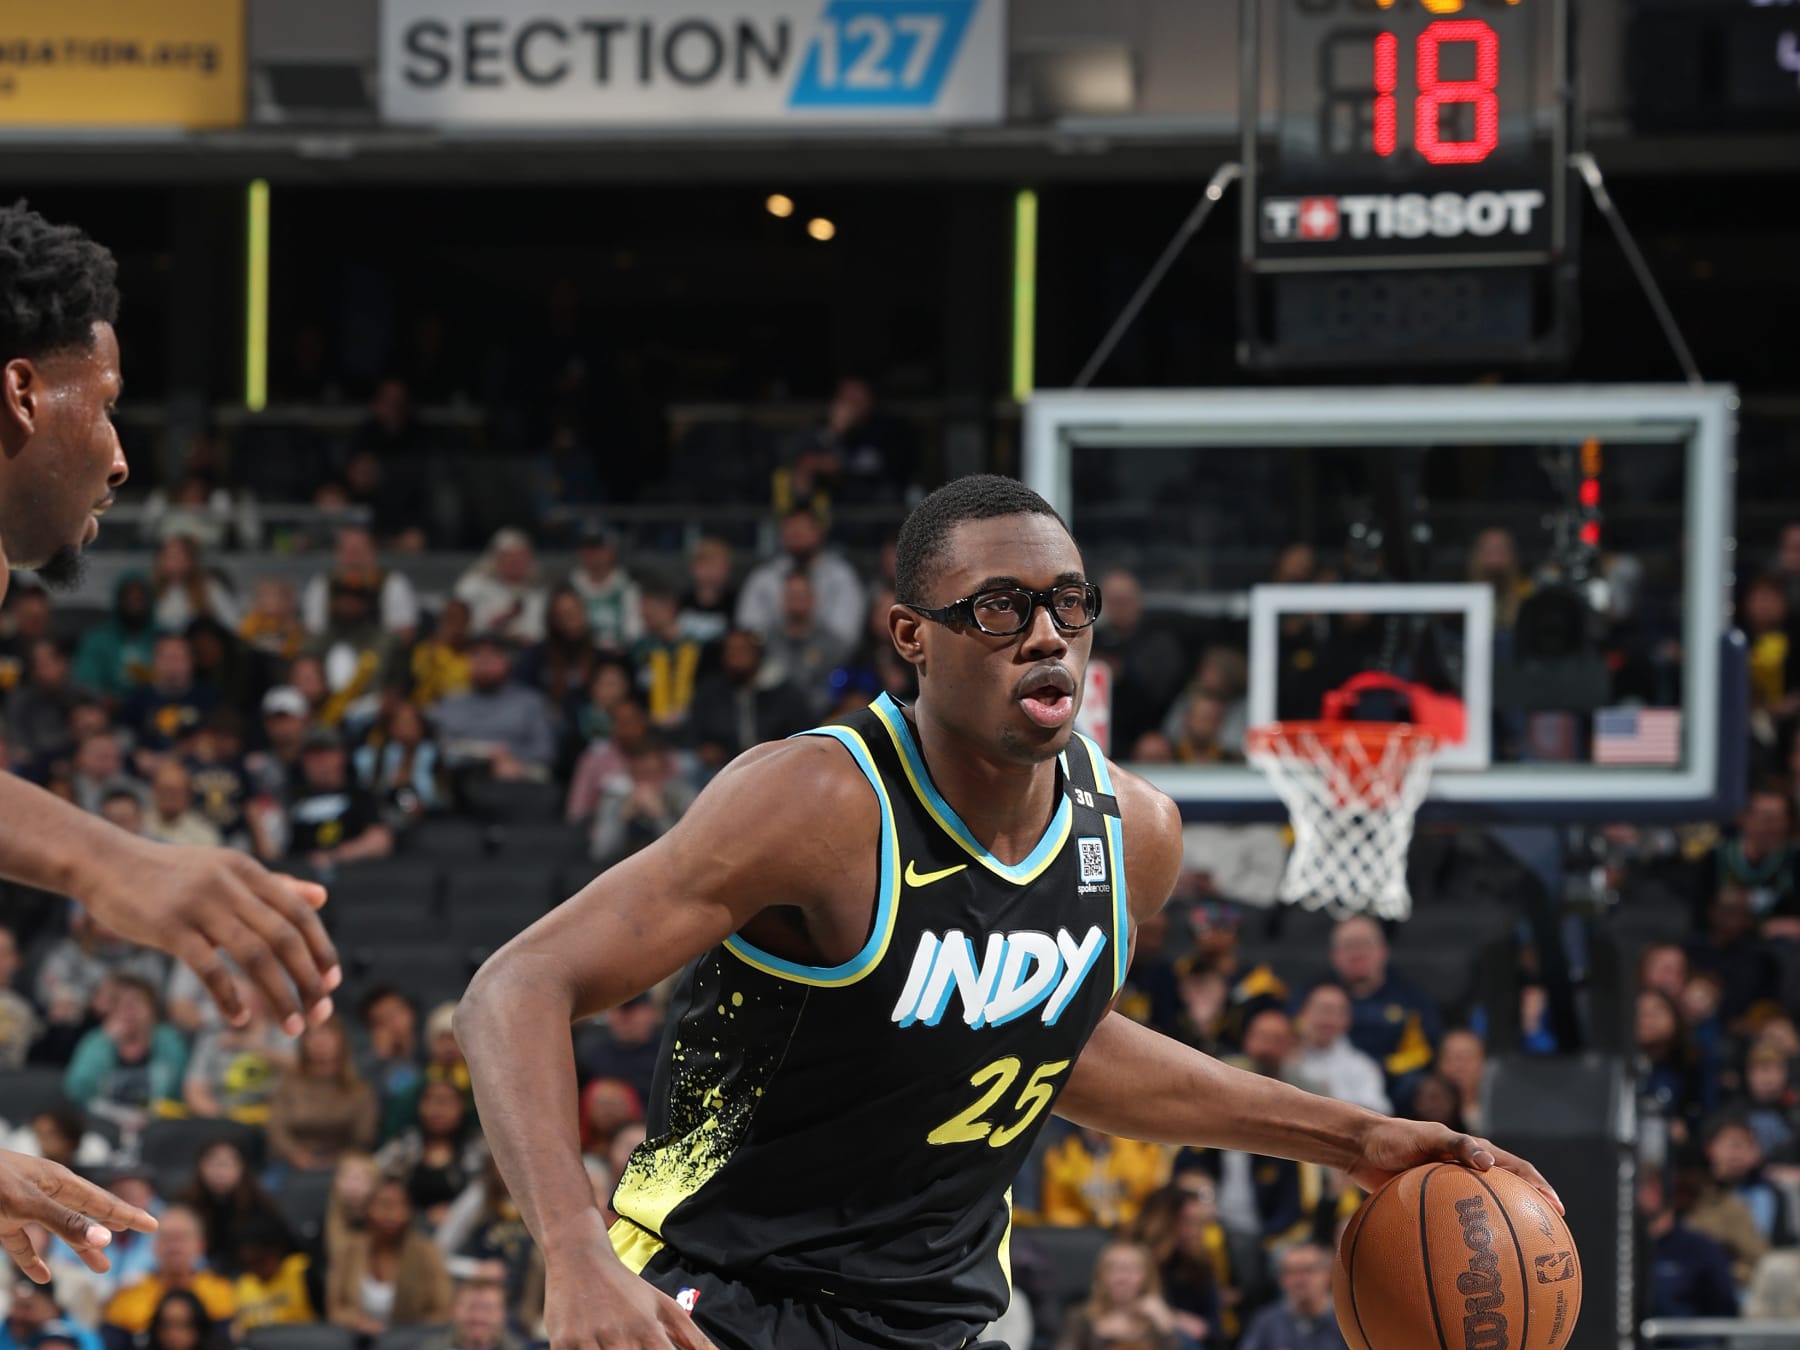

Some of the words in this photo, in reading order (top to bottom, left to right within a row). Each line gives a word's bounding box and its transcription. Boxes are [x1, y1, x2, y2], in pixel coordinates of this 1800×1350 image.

[404, 19, 793, 88] SECTION
[812, 15, 946, 90] 127
[1373, 20, 1498, 164] 18
[1340, 190, 1545, 239] TISSOT
[1074, 788, 1094, 808] 30
[892, 925, 1107, 1030] INDY
[926, 1055, 1070, 1148] 25
